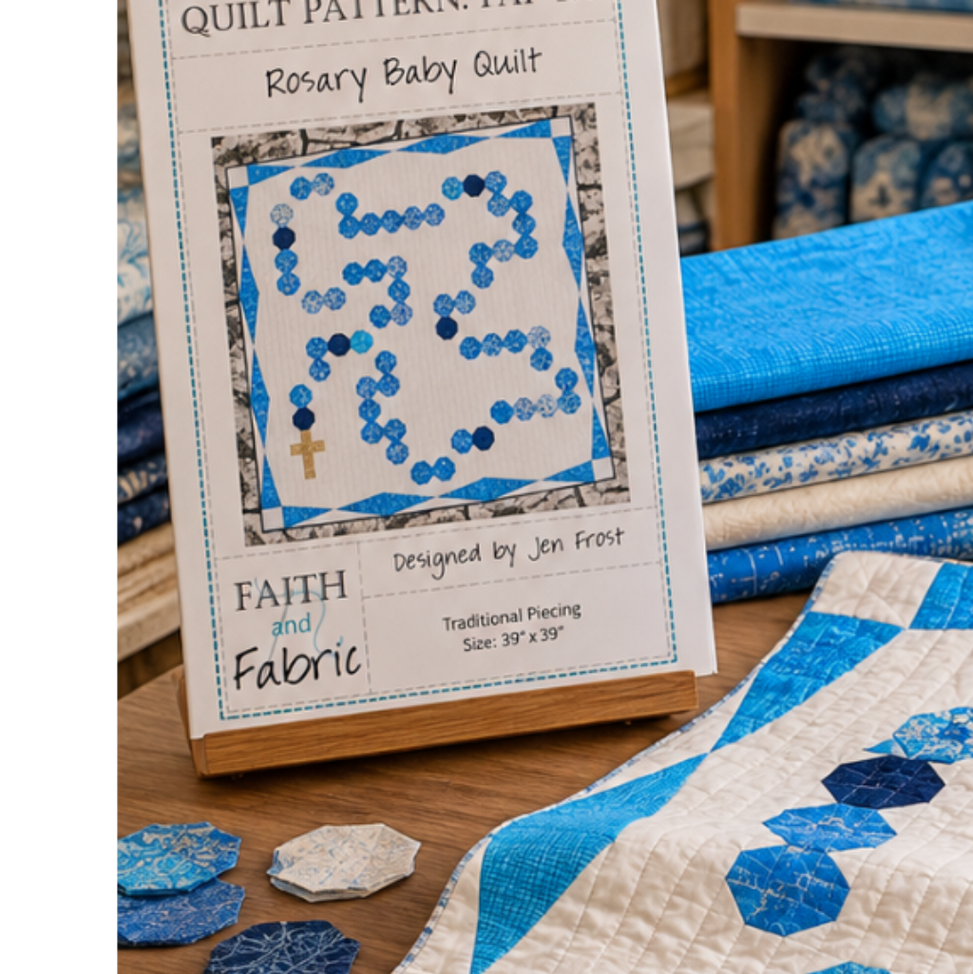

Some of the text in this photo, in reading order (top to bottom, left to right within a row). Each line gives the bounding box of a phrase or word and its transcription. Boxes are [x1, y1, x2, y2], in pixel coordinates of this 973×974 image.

[181, 0, 292, 38] QUILT
[265, 46, 543, 104] Rosary Baby Quilt
[393, 526, 626, 581] Designed by Jen Frost
[233, 569, 349, 613] FAITH
[271, 610, 312, 637] and
[442, 602, 582, 632] Traditional Piecing
[462, 635, 498, 653] Size:
[528, 631, 538, 644] x
[232, 640, 362, 691] Fabric
